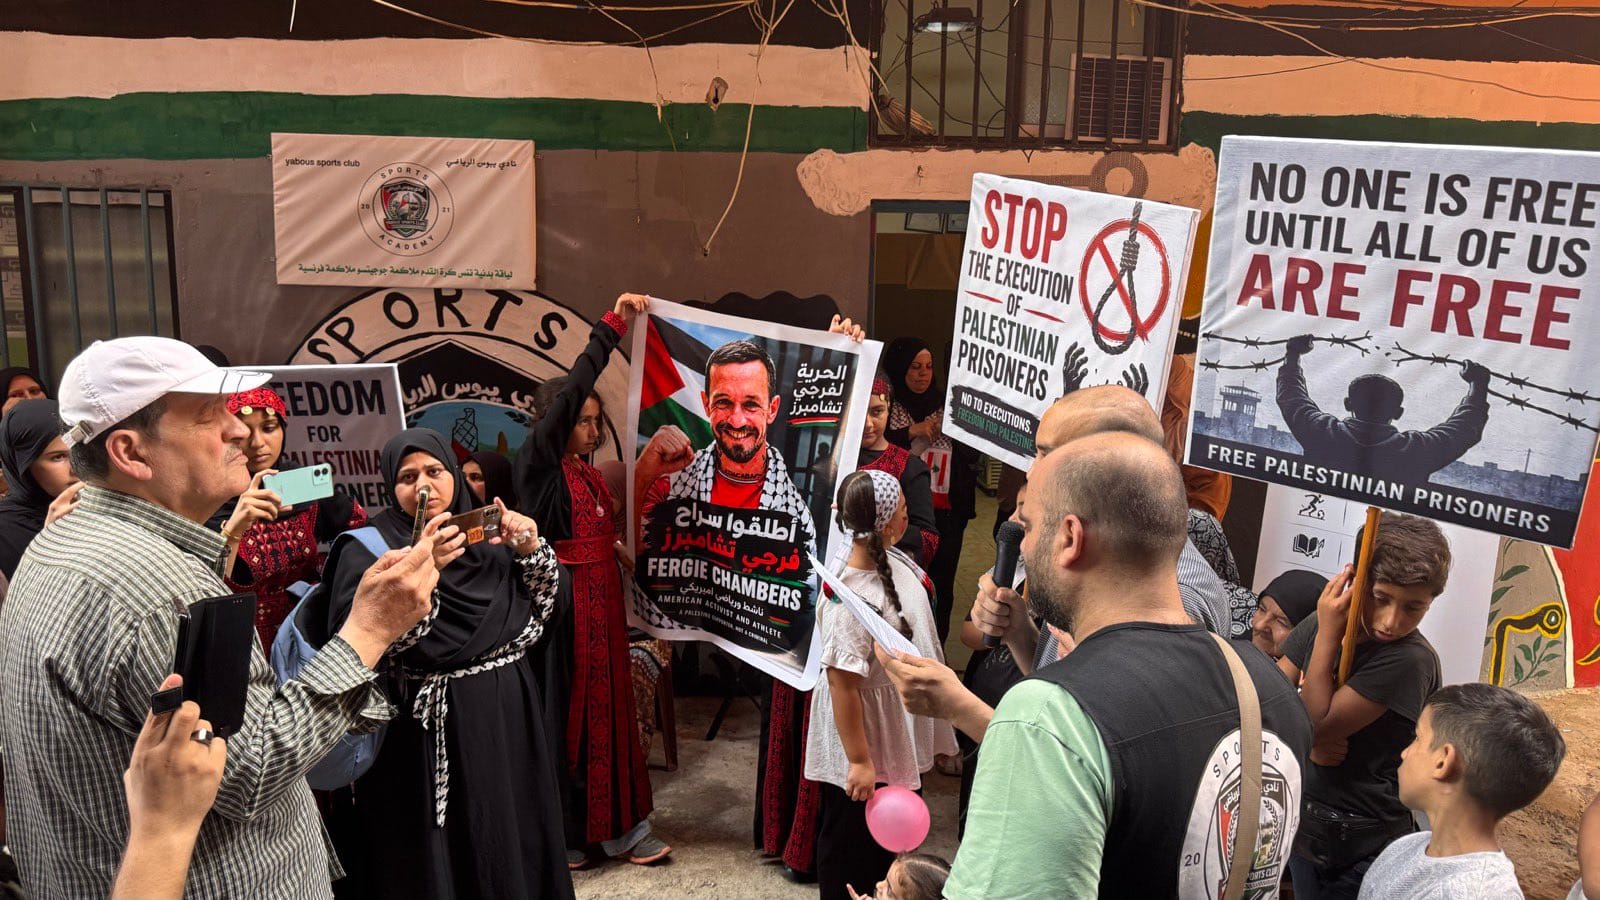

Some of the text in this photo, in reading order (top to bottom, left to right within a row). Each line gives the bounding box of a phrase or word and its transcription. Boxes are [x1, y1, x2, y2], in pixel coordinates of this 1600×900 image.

[285, 157, 361, 168] yabous sports club
[380, 166, 429, 180] SPORTS
[498, 160, 517, 170] نادي
[1249, 161, 1600, 229] NO ONE IS FREE
[981, 189, 1068, 264] STOP
[379, 233, 434, 250] ACADEMY
[1245, 209, 1592, 278] UNTIL ALL OF US
[298, 263, 325, 274] فرنسية
[326, 263, 356, 274] ملاكمة
[389, 266, 419, 276] ملاكمة
[420, 267, 439, 277] القدم
[439, 267, 457, 278] كرة
[474, 270, 494, 279] بدنية
[494, 269, 513, 279] لياقة
[968, 249, 1075, 305] THE EXECUTION
[1006, 293, 1023, 317] OF
[1236, 253, 1582, 351] ARE FREE
[307, 287, 568, 364] SPORTS
[960, 305, 1060, 367] PALESTINIAN
[797, 362, 848, 383] الحرية
[956, 339, 1049, 401] PRISONERS
[402, 373, 437, 409] الريا
[441, 382, 502, 403] يبوس
[793, 382, 844, 401] لفرجي
[789, 400, 843, 416] تشامبرز
[961, 391, 1033, 435] NO TO EXECUTIONS.
[307, 425, 342, 442] FOR
[957, 406, 1035, 452] FREEDOM FOR PALESTINE
[1206, 443, 1552, 533] FREE PALESTINIAN PRISONERS
[675, 502, 799, 543] أطلقوا سراح
[661, 527, 800, 573] فرجي تشامبرز
[647, 557, 802, 611] FERGIE CHAMBERS
[715, 591, 741, 610] ورياضي
[742, 600, 764, 617] ناشط
[657, 594, 782, 639] AMERICAN ACTIVIST AND ATHLETE
[684, 609, 711, 619] PALESTINE
[735, 625, 744, 634] NOT
[748, 631, 769, 645] CRIMINAL
[1213, 740, 1281, 778] SPOTS
[1263, 780, 1279, 796] نادي
[1184, 852, 1201, 867] 20
